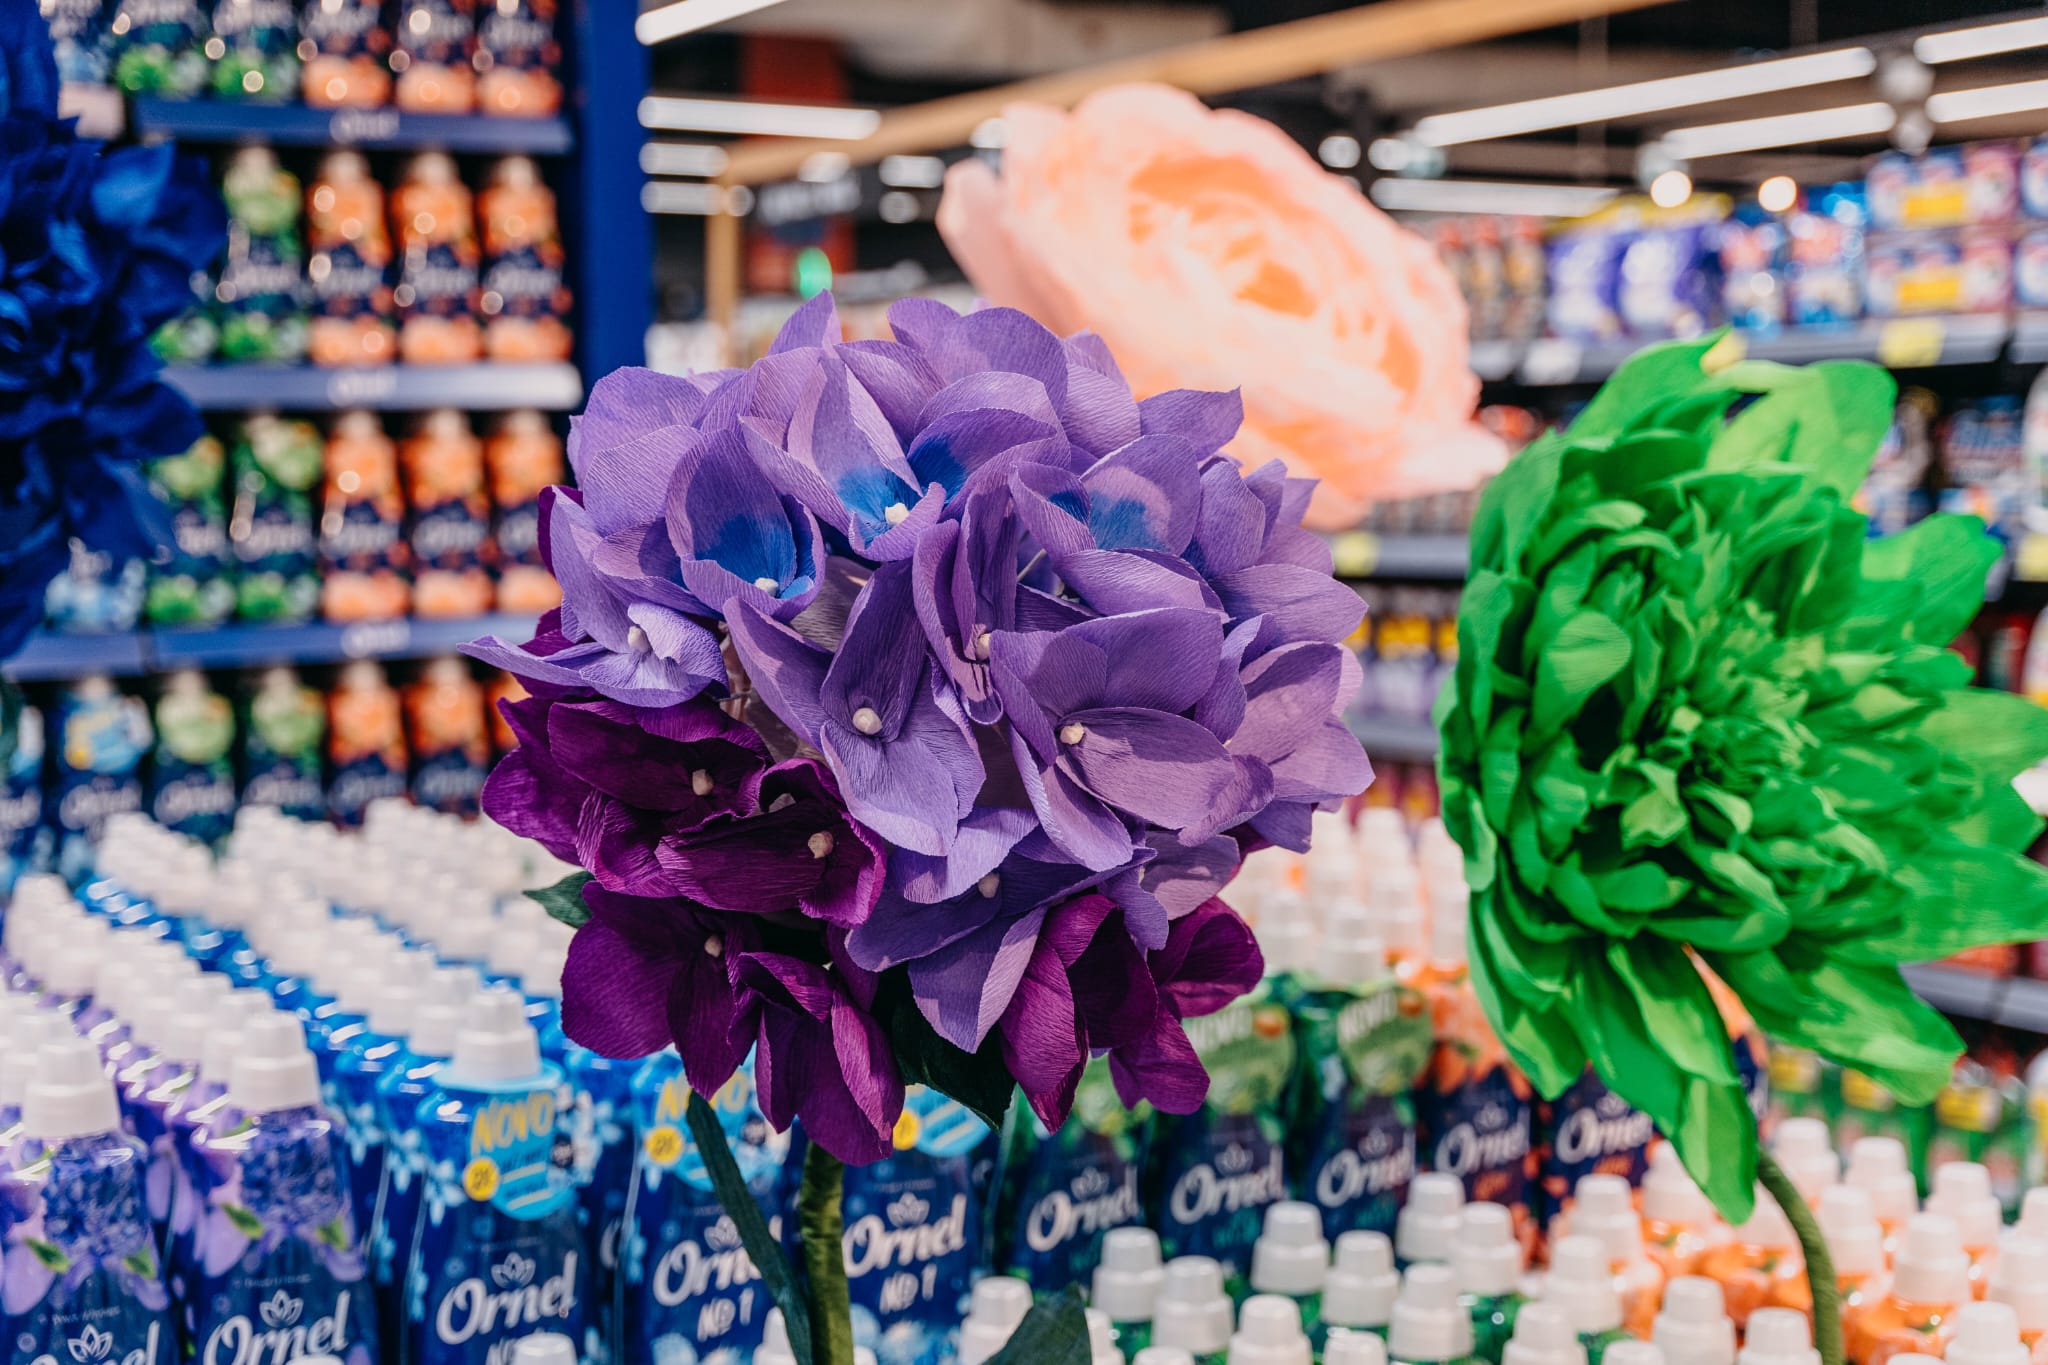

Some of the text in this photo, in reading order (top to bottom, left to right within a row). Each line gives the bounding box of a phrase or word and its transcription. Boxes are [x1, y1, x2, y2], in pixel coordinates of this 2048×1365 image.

[470, 1090, 556, 1157] NOVO
[1556, 1107, 1653, 1164] Orne
[1171, 1144, 1287, 1224] Ornel
[1317, 1126, 1416, 1207] Ornel
[842, 1193, 967, 1278] Ornel
[1026, 1165, 1139, 1251] Ornel
[436, 1250, 578, 1345] Ornel
[653, 1215, 783, 1306] Orn
[922, 1263, 938, 1300] 1
[203, 1289, 351, 1365] Ornel
[739, 1288, 754, 1326] 1
